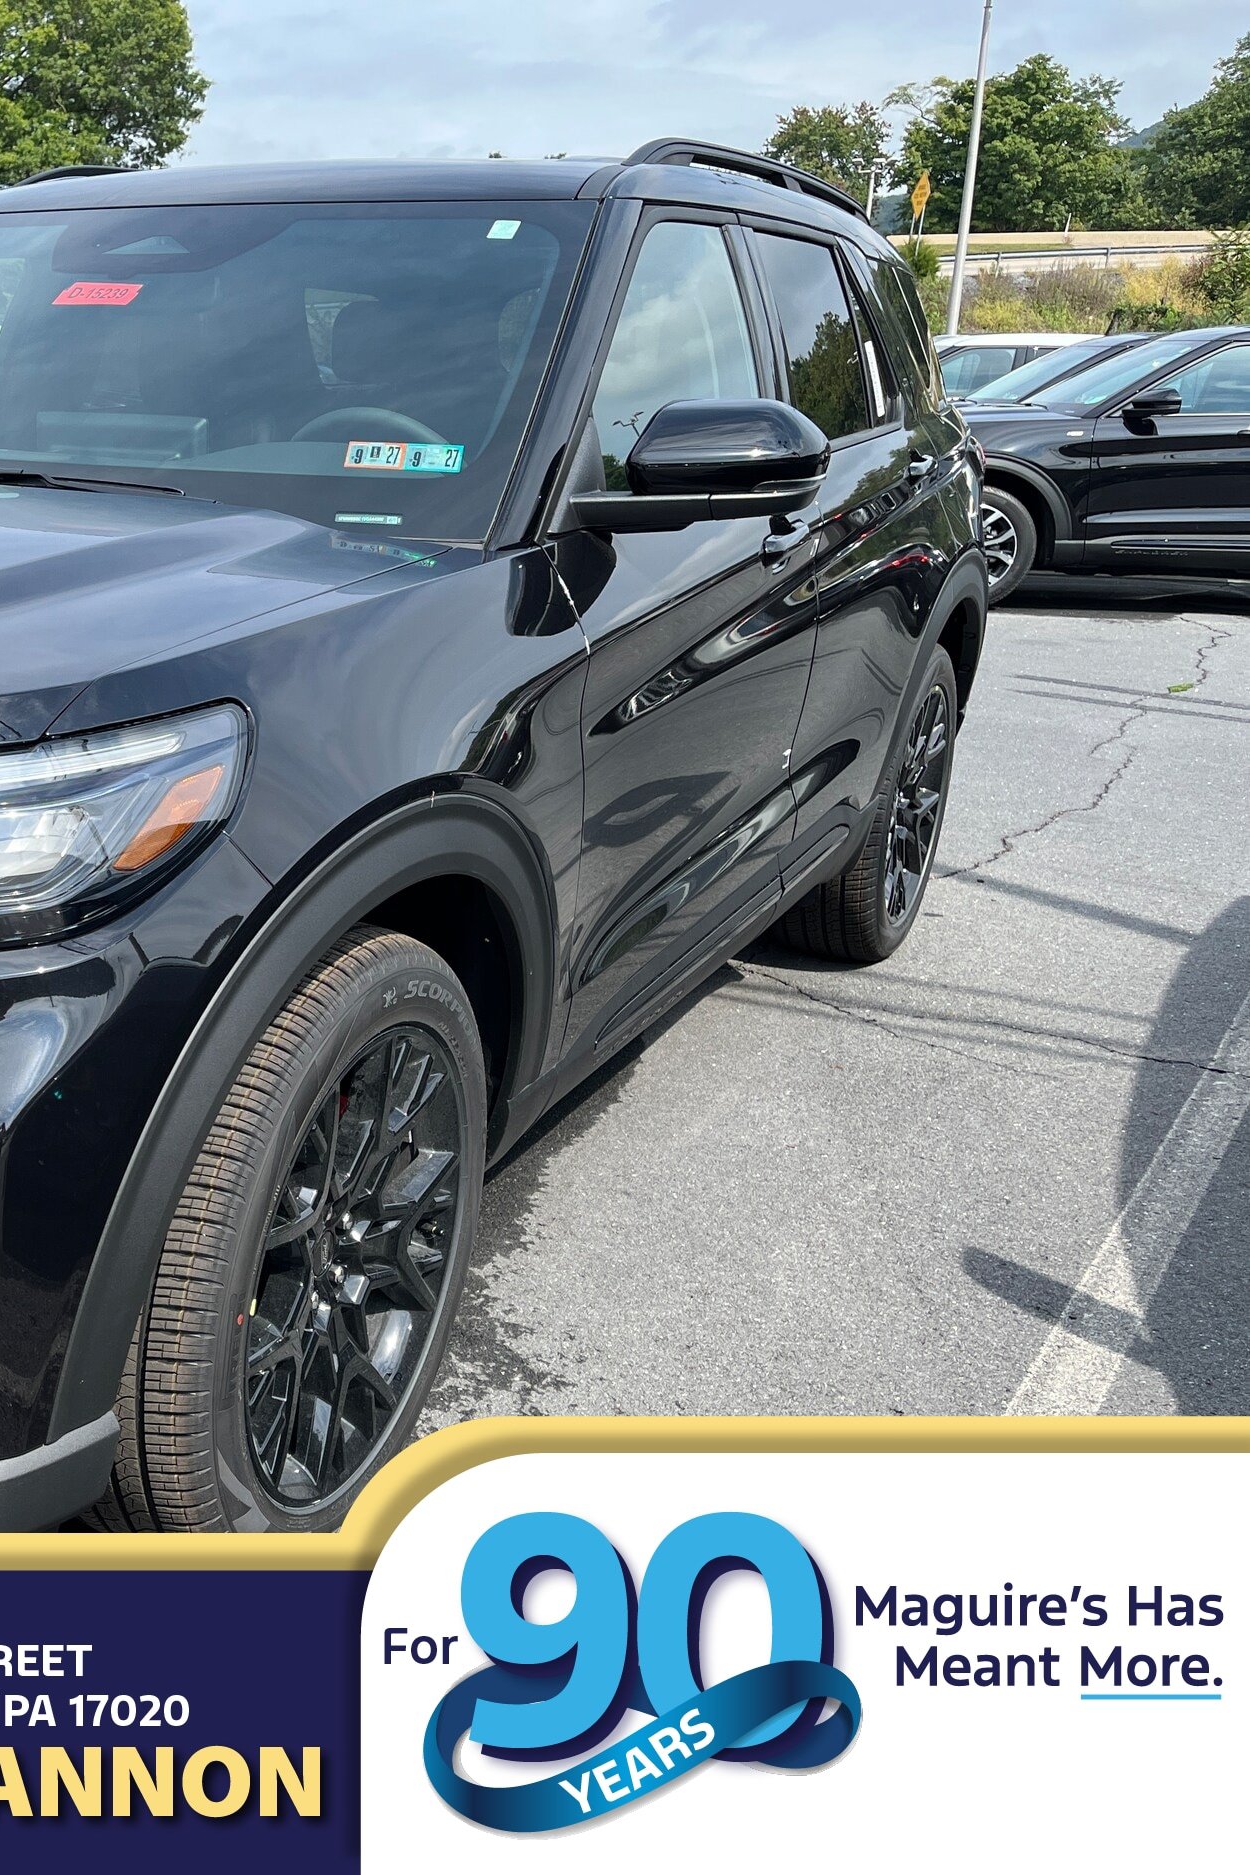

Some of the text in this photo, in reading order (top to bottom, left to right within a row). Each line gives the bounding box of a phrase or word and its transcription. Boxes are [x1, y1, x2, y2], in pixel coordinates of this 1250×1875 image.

[67, 286, 130, 299] D-15239
[353, 448, 364, 465] 9
[385, 446, 401, 466] 27
[411, 449, 460, 469] 9 27
